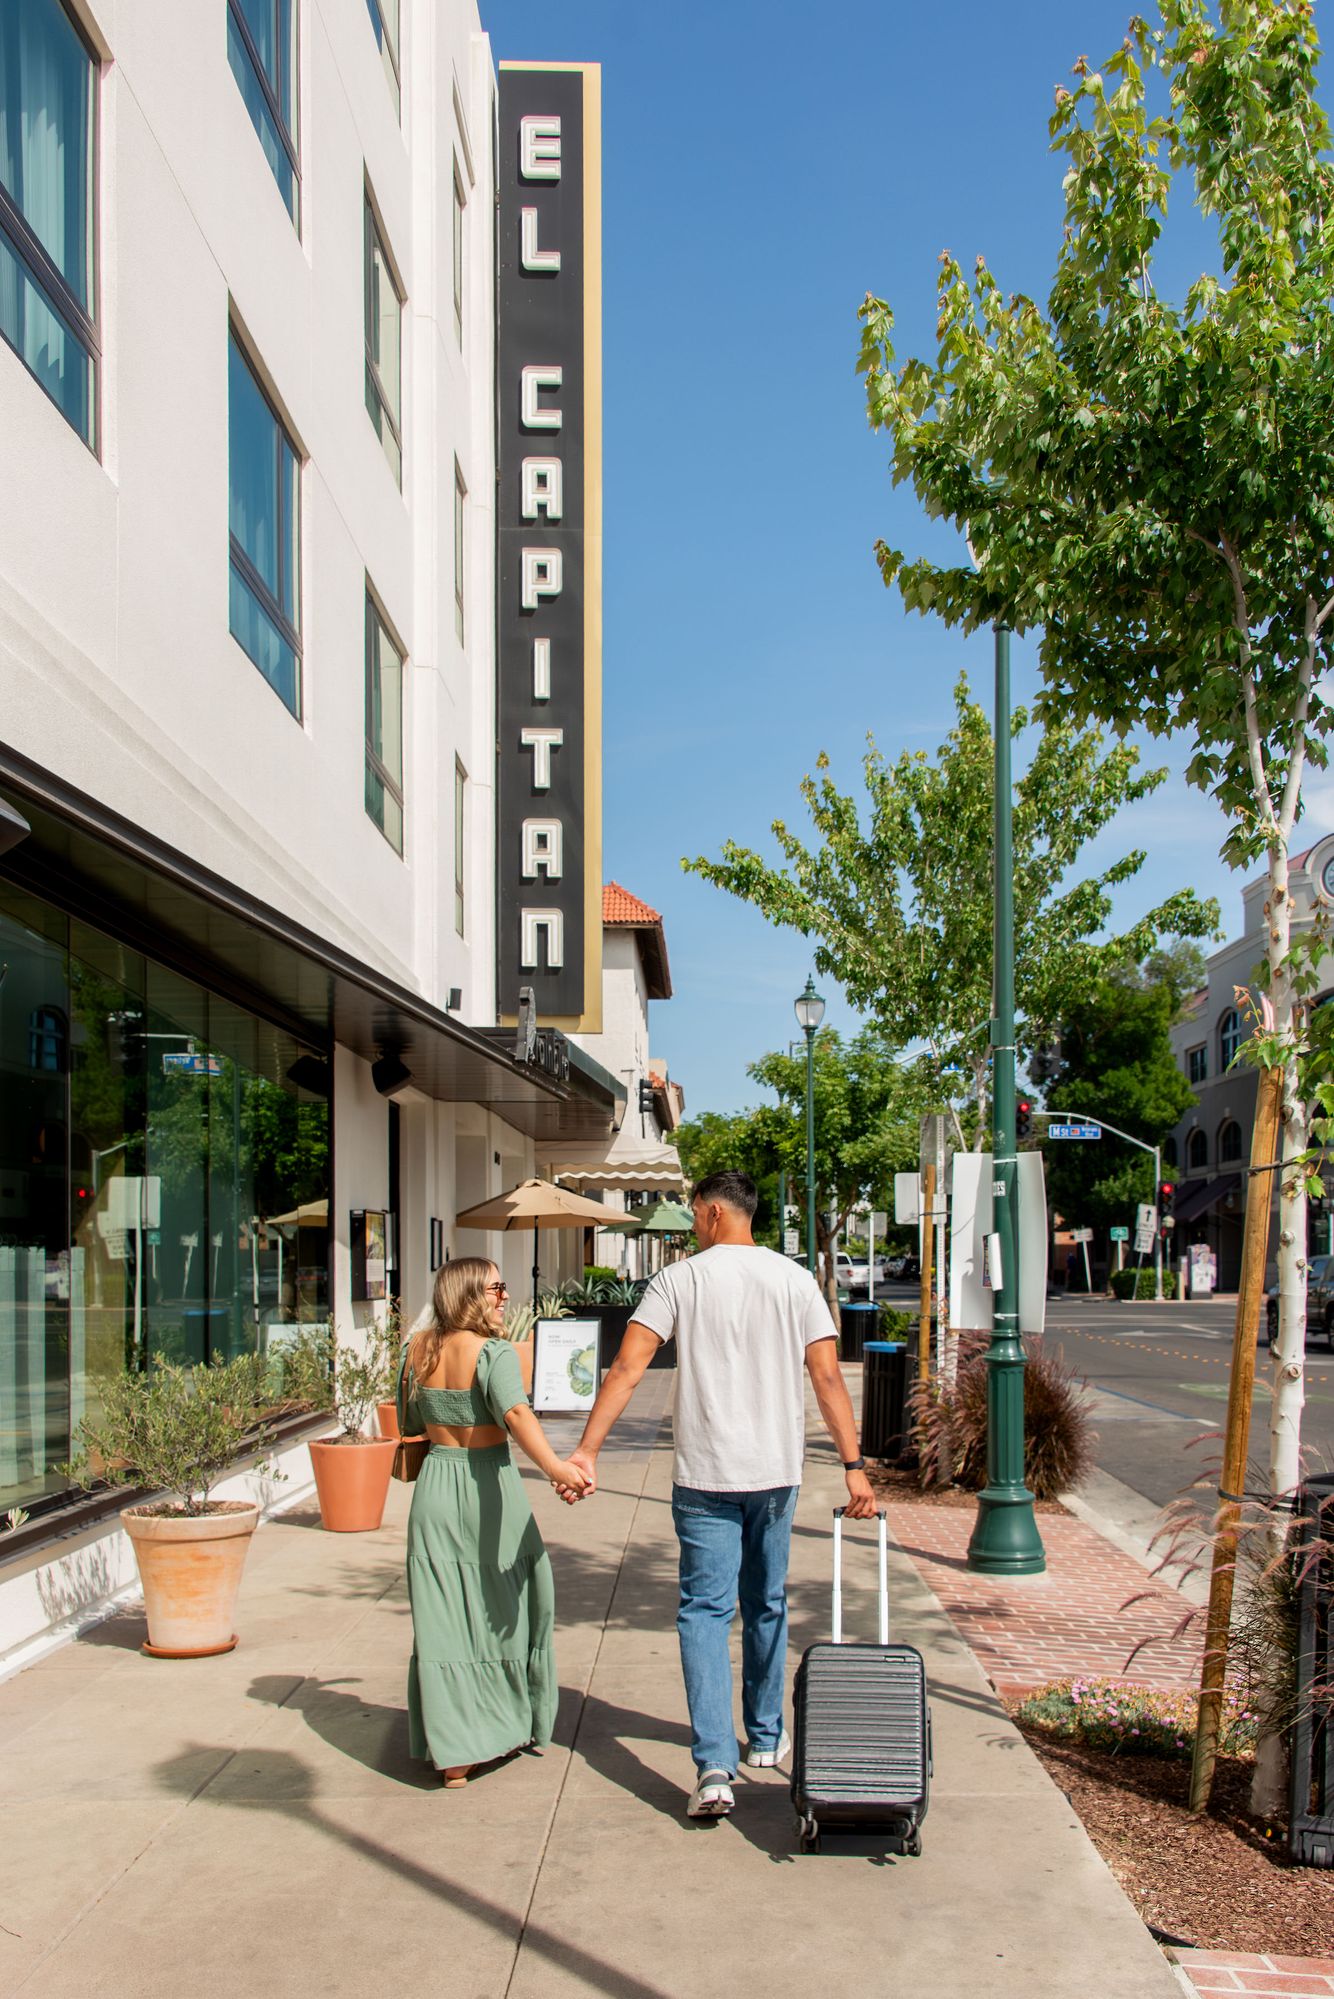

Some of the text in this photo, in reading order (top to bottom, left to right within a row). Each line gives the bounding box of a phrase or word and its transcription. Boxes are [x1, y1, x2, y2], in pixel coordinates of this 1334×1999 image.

[520, 115, 562, 271] EL
[521, 365, 563, 968] CAPITAN
[1053, 1127, 1069, 1137] M St
